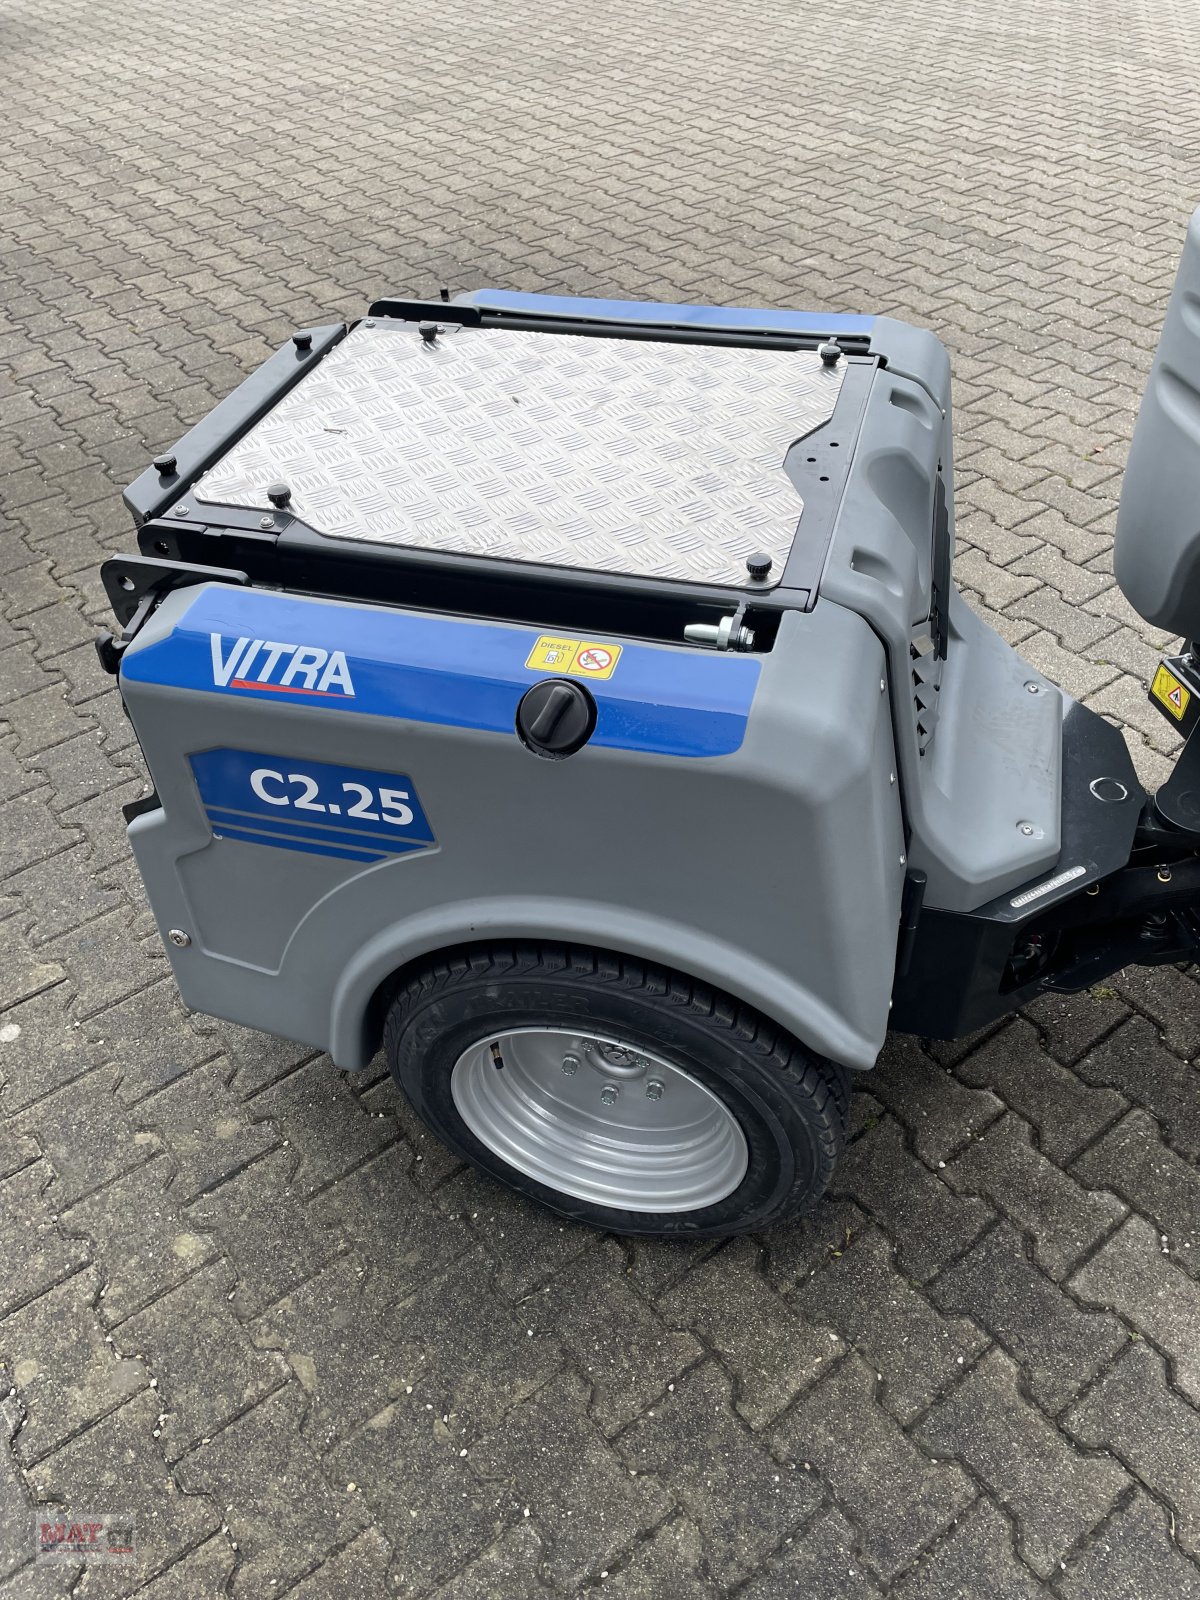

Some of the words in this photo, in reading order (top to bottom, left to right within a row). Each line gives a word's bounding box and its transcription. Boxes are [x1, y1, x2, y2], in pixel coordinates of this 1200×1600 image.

[210, 632, 356, 696] VITRA
[540, 641, 574, 652] DIESEL
[250, 768, 414, 826] C2.25
